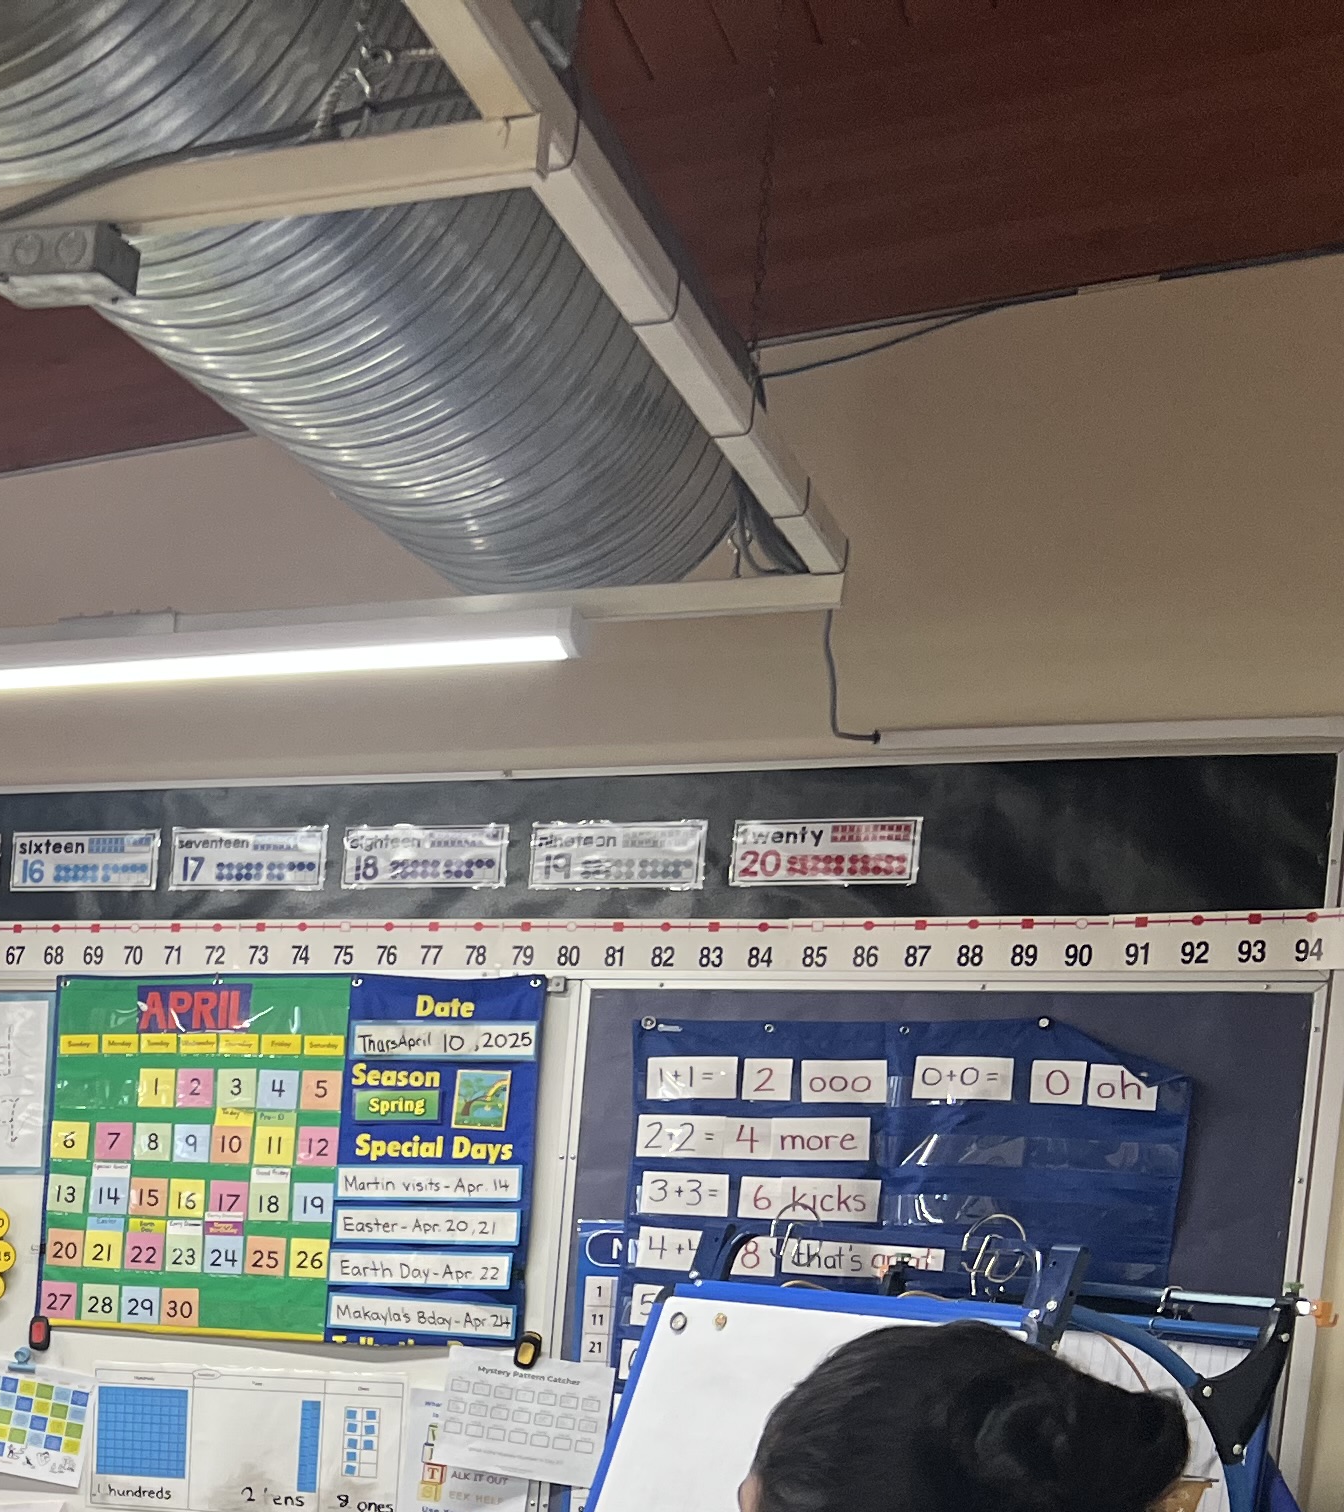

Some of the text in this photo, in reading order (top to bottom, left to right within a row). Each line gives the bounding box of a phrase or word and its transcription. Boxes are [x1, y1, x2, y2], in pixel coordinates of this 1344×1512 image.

[178, 837, 250, 850] seventeen
[739, 826, 824, 847] twenty
[19, 839, 85, 856] sixteen
[21, 861, 44, 884] 16
[181, 855, 205, 882] 17
[353, 856, 379, 882] 18
[739, 851, 781, 878] 20
[802, 938, 1323, 967] 85 86 87 88 89 90 91 92 93 94
[138, 990, 246, 1030] APRIL
[415, 994, 475, 1018] Date
[443, 1034, 465, 1053] 10
[351, 1062, 441, 1087] Season
[753, 1067, 776, 1092] 2
[230, 1077, 242, 1096] 3
[271, 1079, 285, 1098] 4
[314, 1079, 328, 1098] 5
[1096, 1070, 1142, 1101] oh
[368, 1097, 426, 1116] Spring
[307, 1137, 330, 1157] 12
[735, 1124, 759, 1153] 4
[780, 1132, 858, 1152] more
[355, 1133, 513, 1164] Special Days
[343, 1175, 396, 1193] Martin
[493, 1178, 510, 1192] 14
[752, 1184, 867, 1213] 6 kicks
[343, 1216, 398, 1233] Easter
[51, 1240, 78, 1259] 20
[740, 1240, 760, 1269] 8
[296, 1250, 324, 1269] 26
[340, 1259, 393, 1277] Earth
[399, 1262, 430, 1284] Day
[479, 1266, 500, 1281] 22
[596, 1285, 603, 1298] 1
[46, 1293, 72, 1311] 27
[166, 1300, 193, 1319] 30
[417, 1311, 452, 1330] Bday
[491, 1314, 511, 1329] 24
[591, 1313, 605, 1326] 11
[588, 1341, 603, 1354] 21
[477, 1365, 581, 1386] Mystery Pattern Catcher
[473, 1473, 485, 1483] IT
[486, 1475, 509, 1486] OUT
[107, 1483, 172, 1501] hundreds
[241, 1486, 255, 1502] 2
